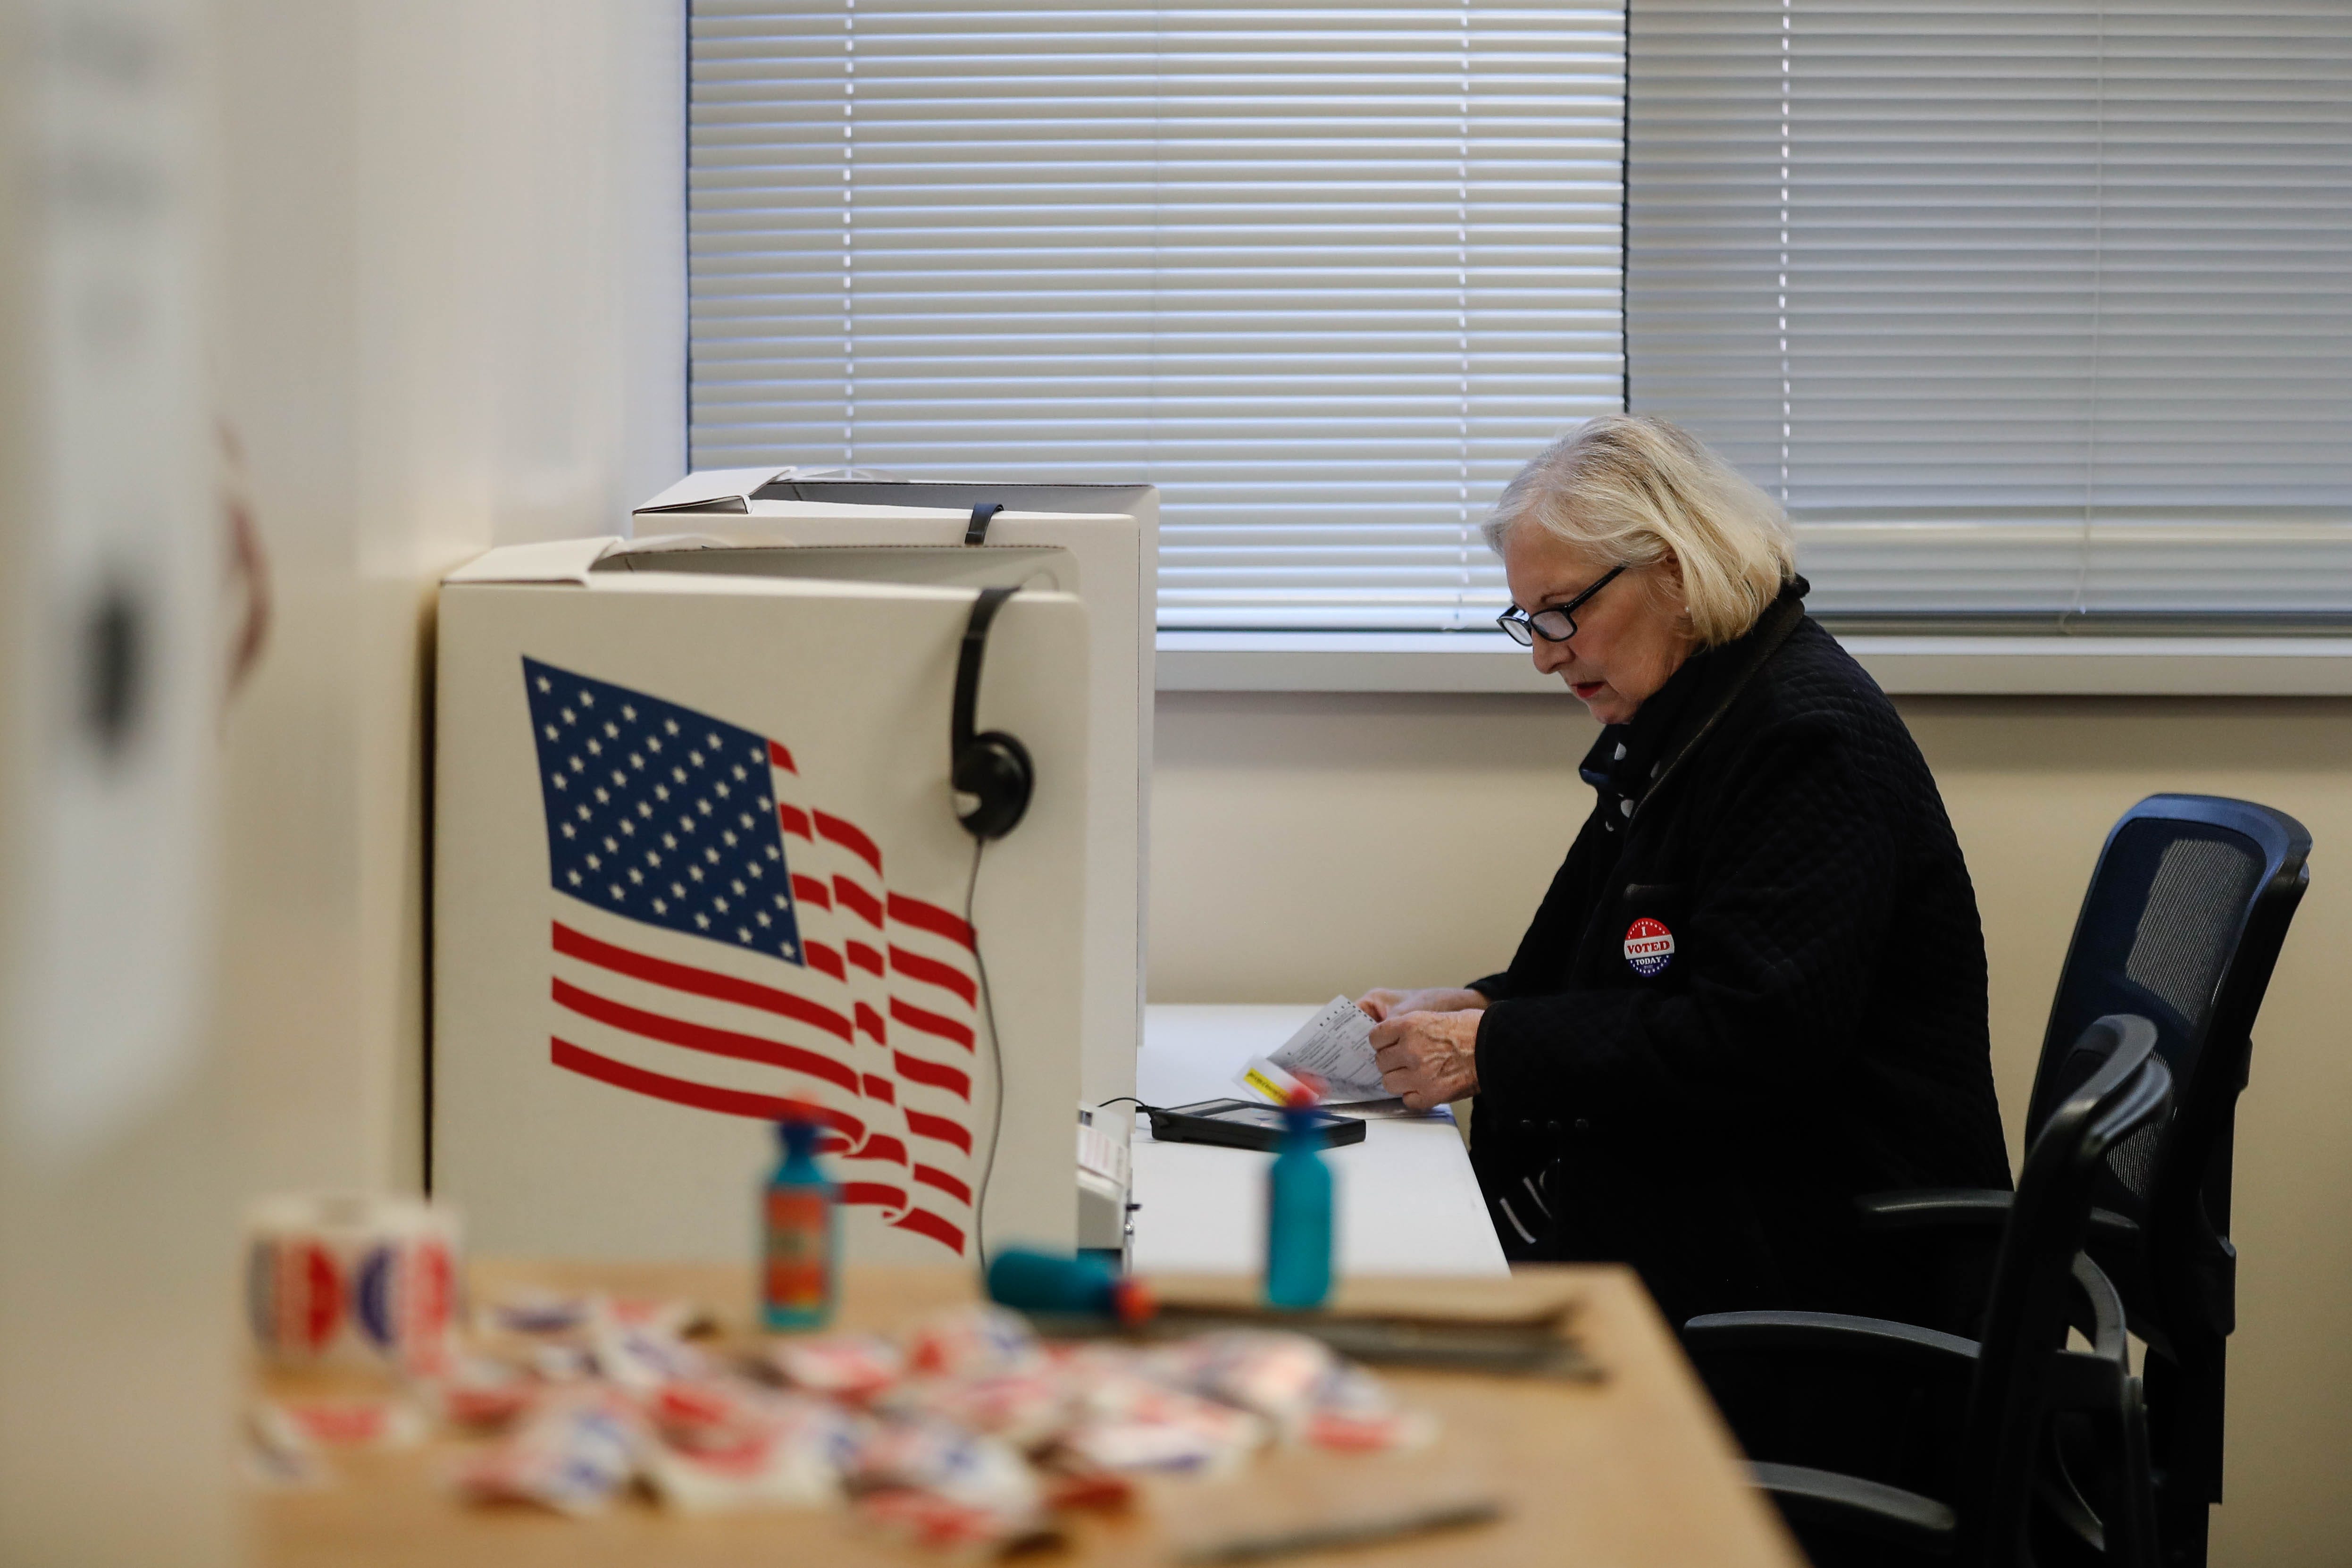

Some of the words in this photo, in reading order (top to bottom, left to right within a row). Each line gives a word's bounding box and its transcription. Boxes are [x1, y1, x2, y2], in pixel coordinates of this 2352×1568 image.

[1641, 926, 1647, 936] I
[1627, 940, 1670, 955] VOTED
[1635, 956, 1662, 965] TODAY
